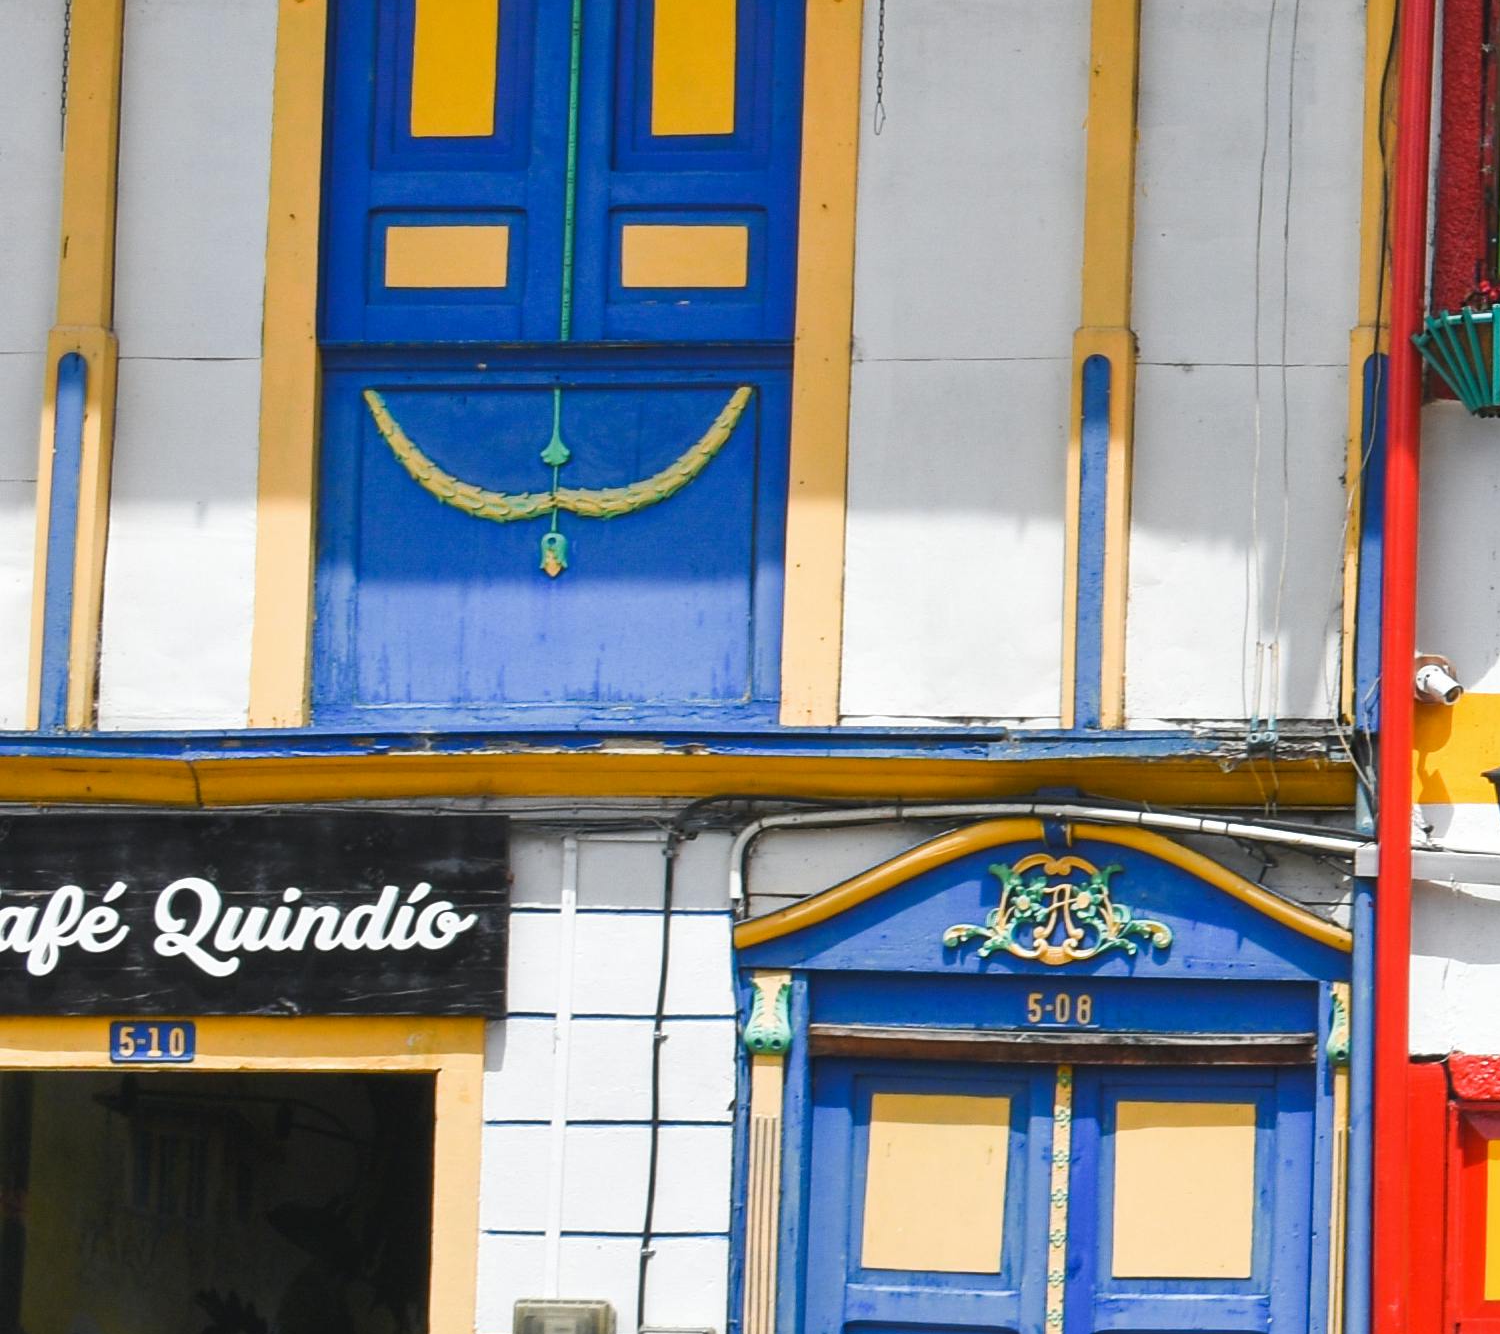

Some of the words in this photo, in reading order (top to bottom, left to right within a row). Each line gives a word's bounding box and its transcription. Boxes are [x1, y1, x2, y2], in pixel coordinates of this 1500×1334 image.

[0, 881, 129, 977] afé
[154, 876, 479, 978] Quindío
[1026, 992, 1094, 1026] 5-08
[118, 1026, 187, 1058] 5-10
